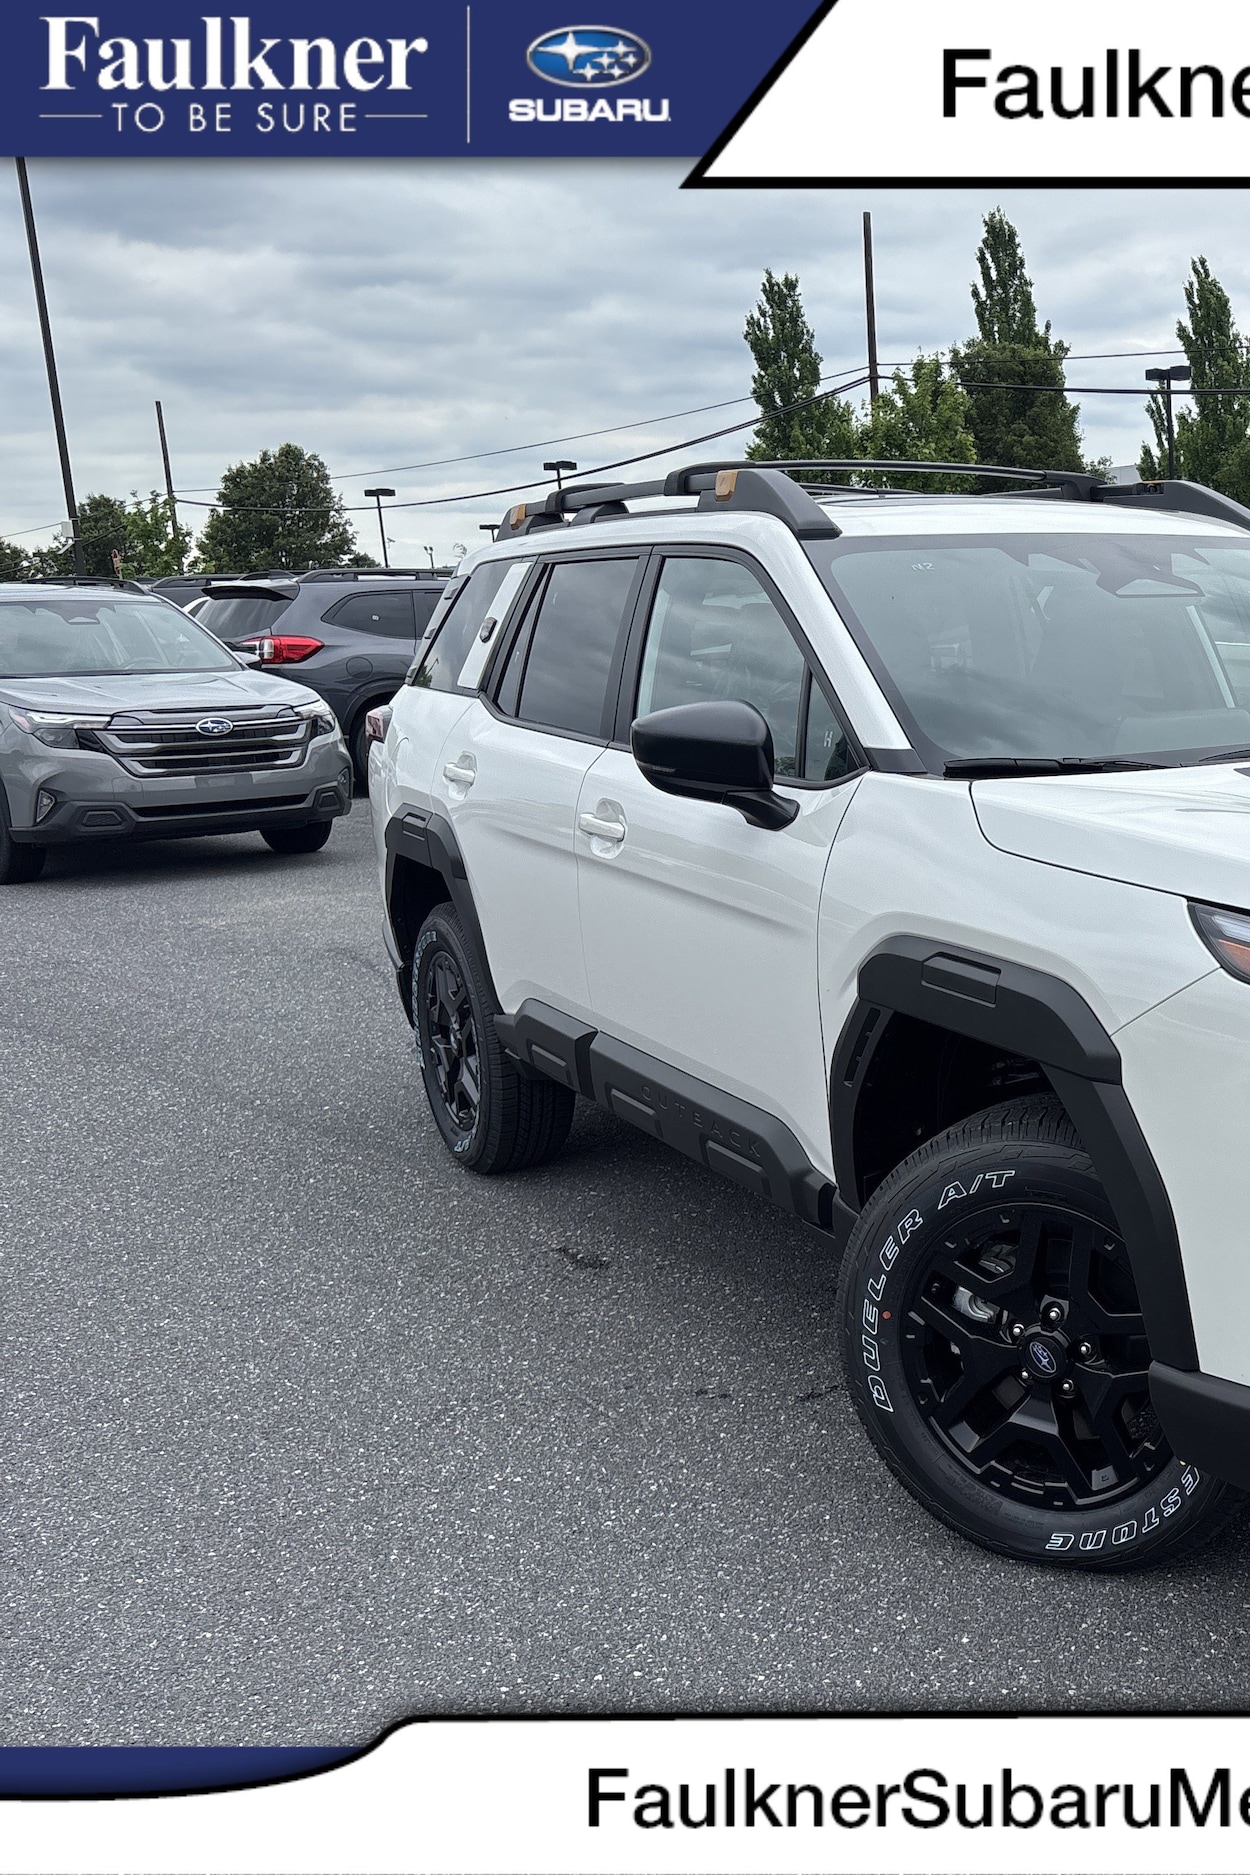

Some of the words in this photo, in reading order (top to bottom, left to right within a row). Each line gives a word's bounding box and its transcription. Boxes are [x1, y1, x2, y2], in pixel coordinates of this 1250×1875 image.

[861, 1207, 924, 1413] DUELER
[937, 1169, 1016, 1211] A/T
[1044, 1464, 1201, 1551] ESTONE
